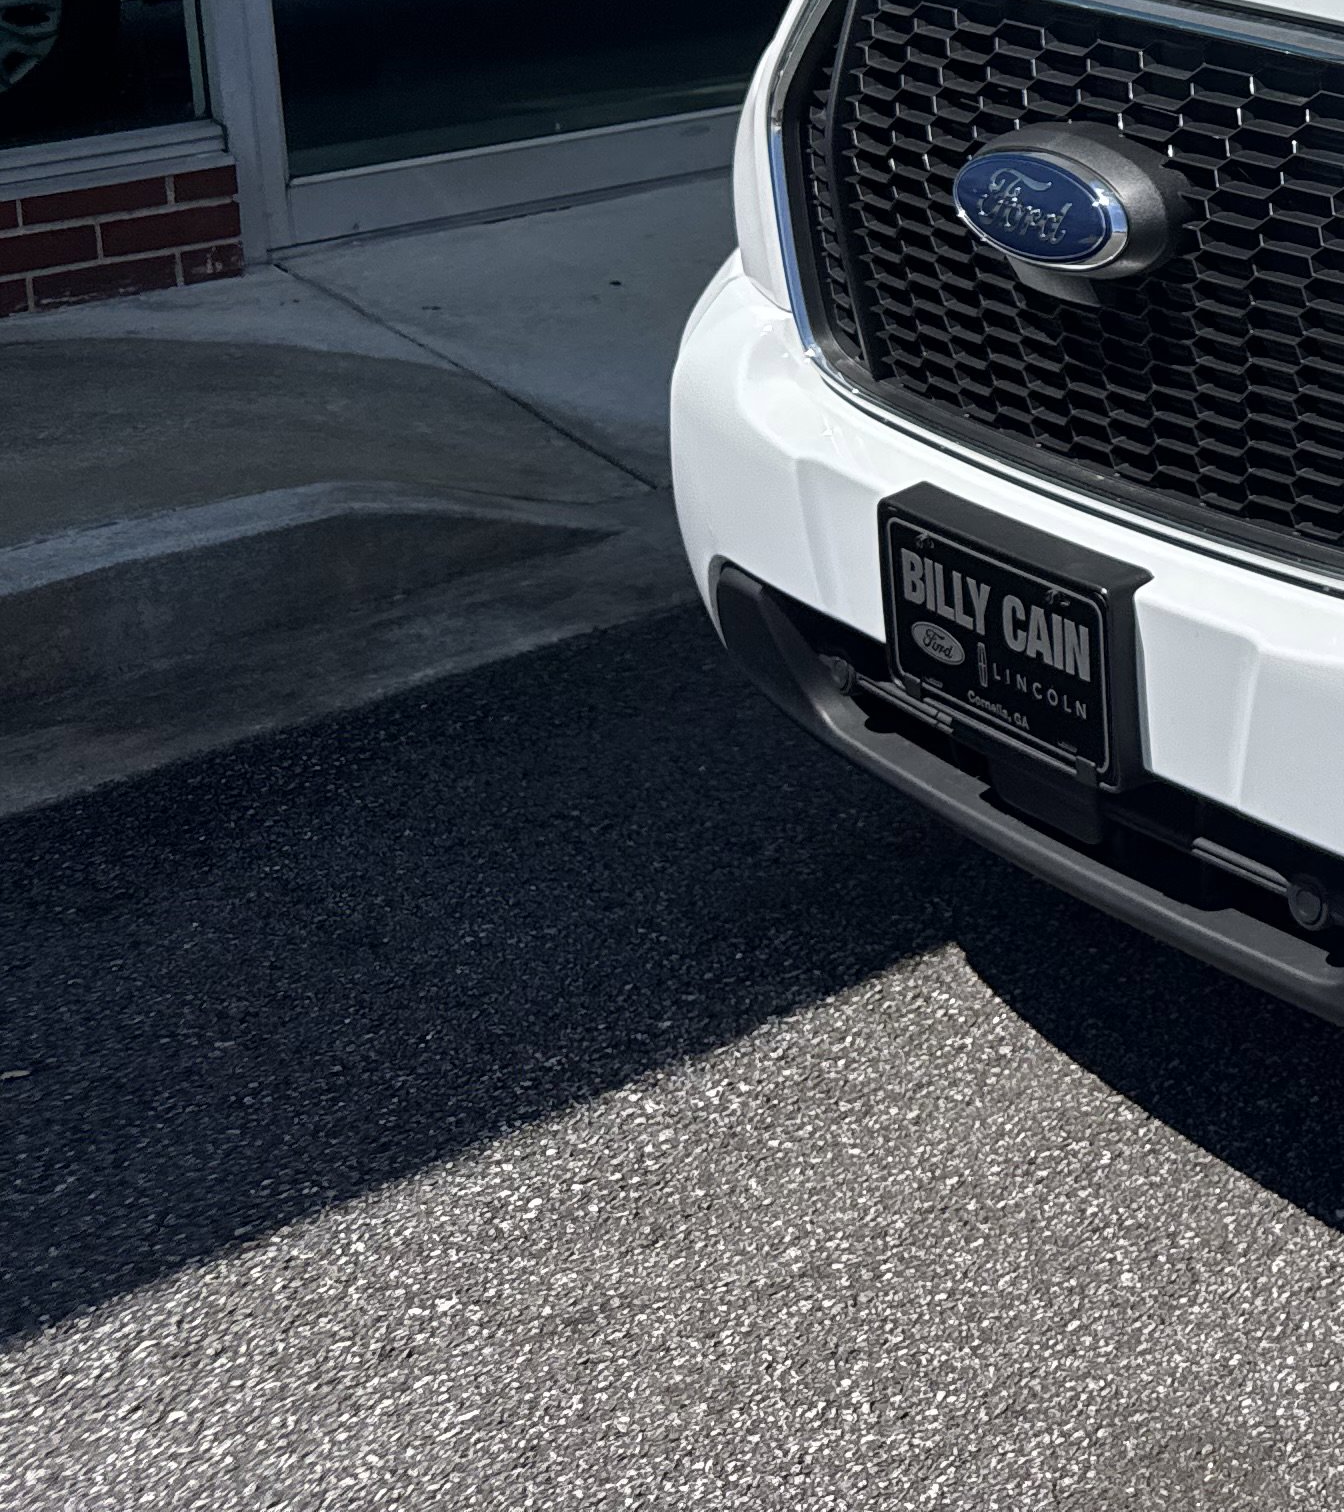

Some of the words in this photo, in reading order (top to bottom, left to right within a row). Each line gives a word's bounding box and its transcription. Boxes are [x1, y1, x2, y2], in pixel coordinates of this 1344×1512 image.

[978, 168, 1073, 245] Ford
[900, 547, 992, 636] BILLY
[1001, 594, 1092, 682] CAIN
[993, 662, 1087, 720] LINCOLN
[1013, 712, 1030, 731] GA
